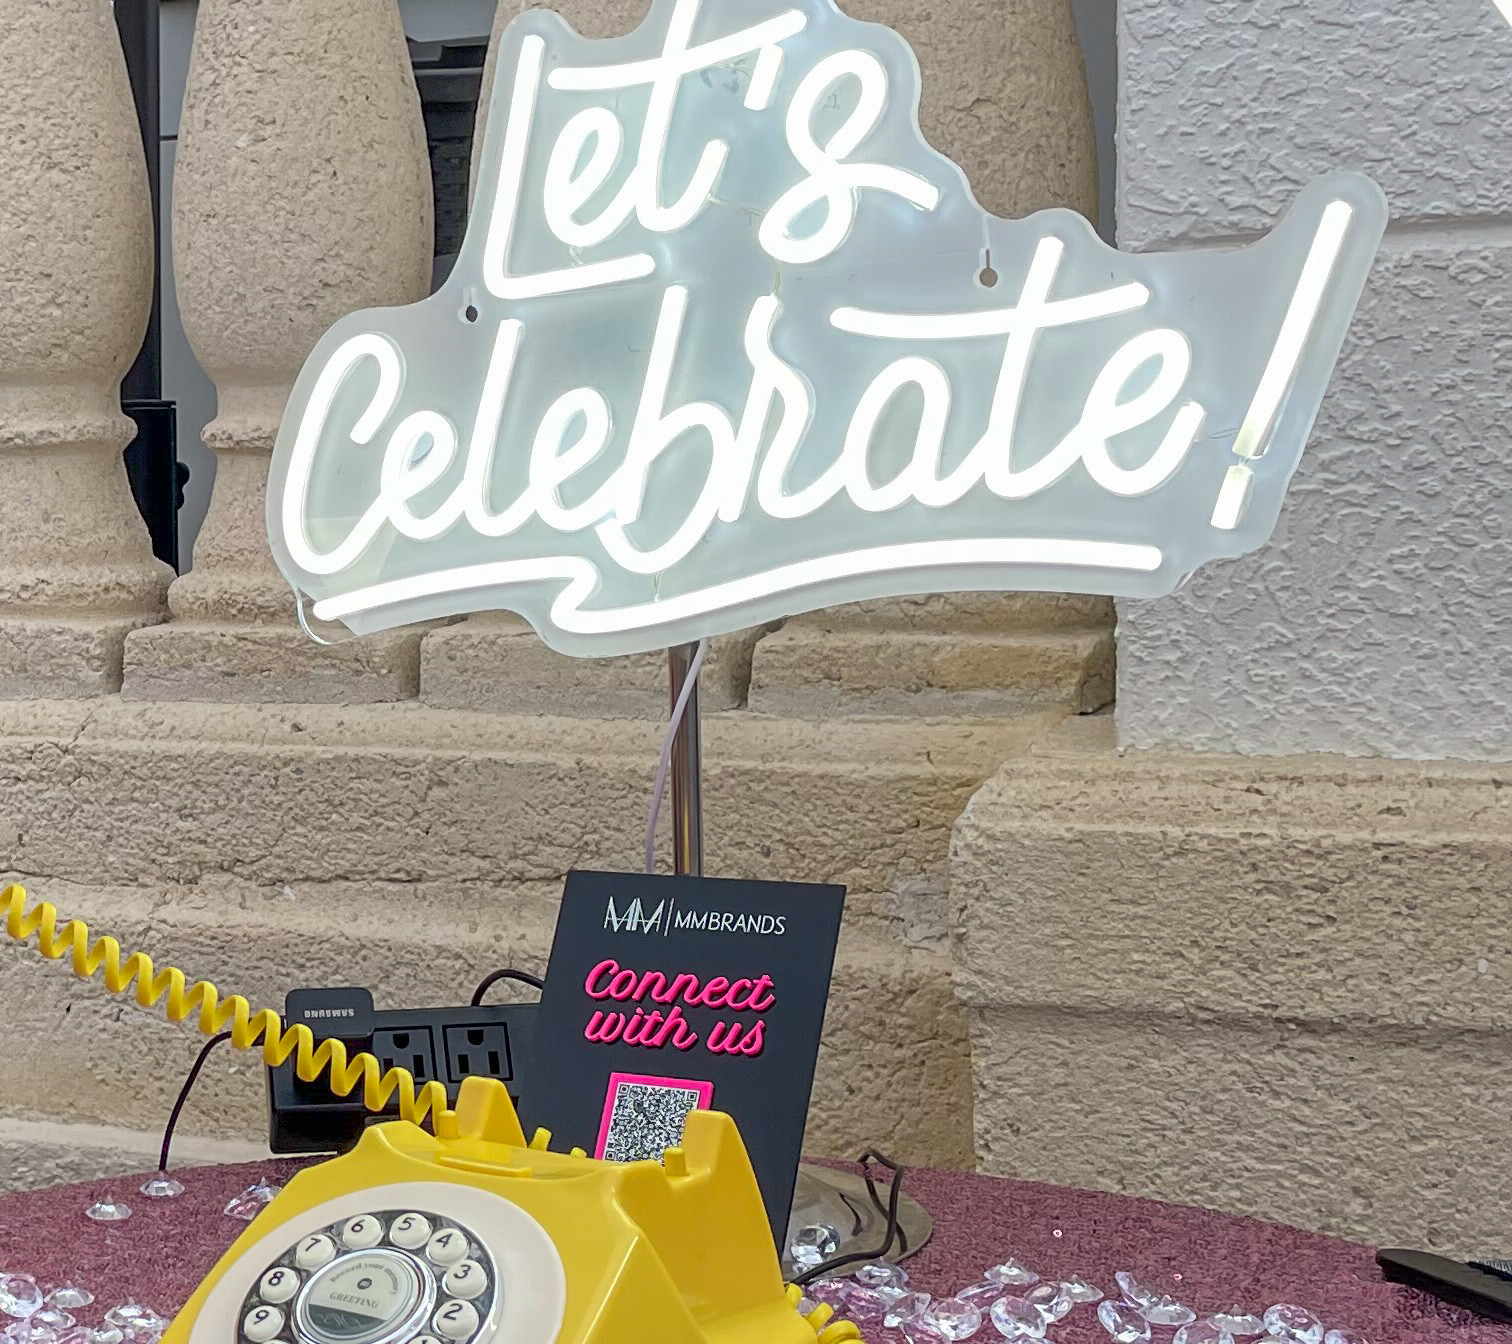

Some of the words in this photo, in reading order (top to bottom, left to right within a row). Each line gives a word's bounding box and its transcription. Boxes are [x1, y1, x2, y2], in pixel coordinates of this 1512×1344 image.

[283, 200, 1354, 574] Celebrate!
[674, 909, 787, 935] MMBRANDS
[585, 958, 776, 1011] Connect
[584, 1006, 698, 1051] with
[706, 1019, 767, 1056] us
[351, 1218, 365, 1233] 6
[398, 1217, 415, 1231] 5
[305, 1237, 322, 1252] 7
[436, 1233, 454, 1248] 4
[268, 1271, 285, 1287] 8
[453, 1264, 472, 1280] 3
[253, 1309, 270, 1324] 9
[442, 1303, 463, 1321] 2
